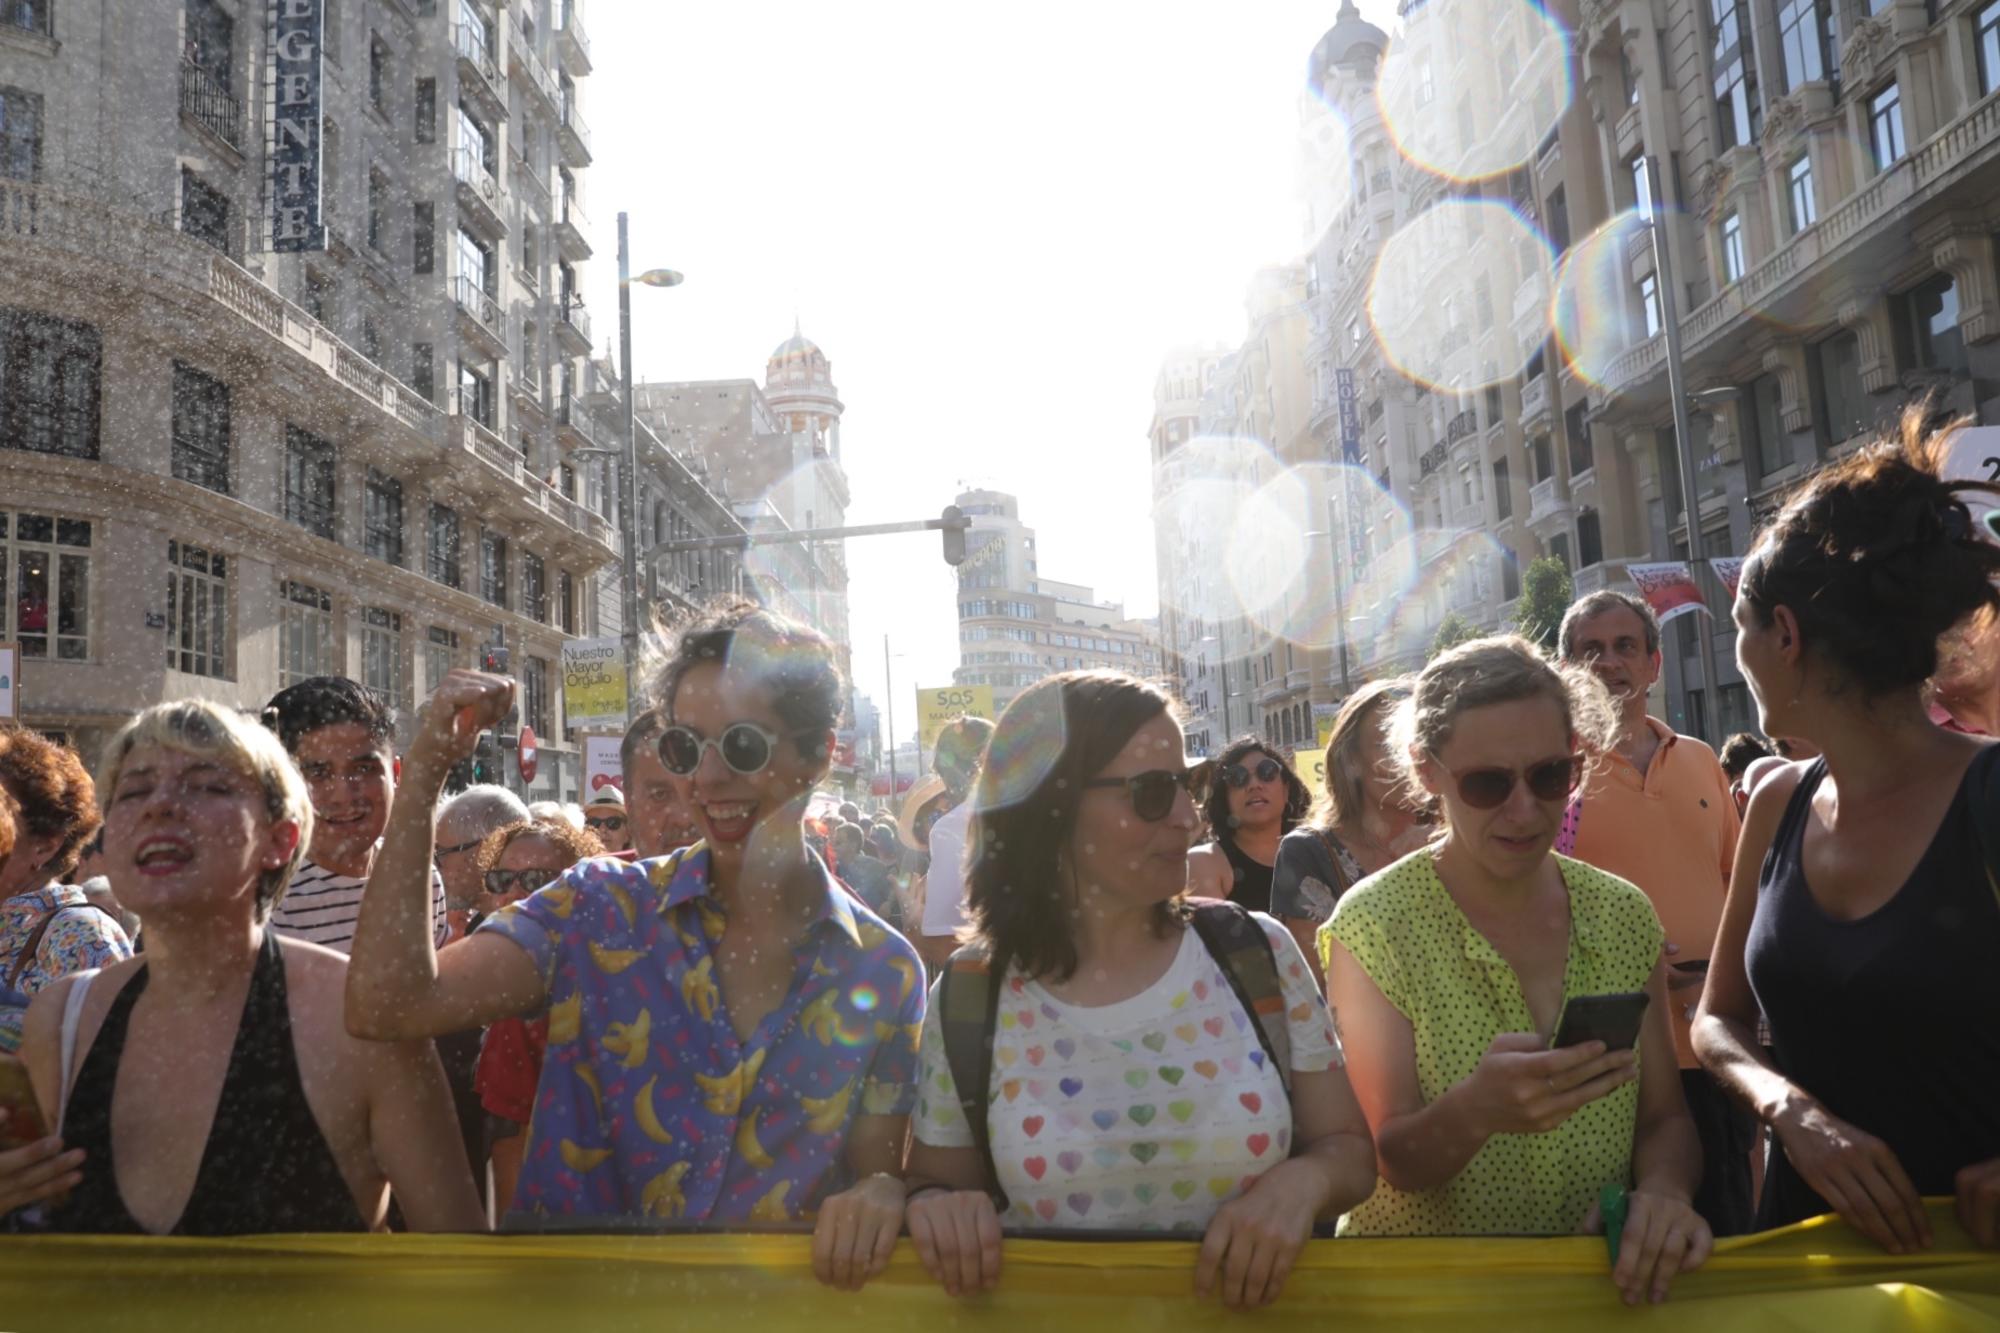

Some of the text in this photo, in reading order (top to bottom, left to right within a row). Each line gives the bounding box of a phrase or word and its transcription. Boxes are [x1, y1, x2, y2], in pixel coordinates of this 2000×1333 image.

[1338, 371, 1356, 441] HOTEL
[564, 647, 614, 661] Nuestro
[566, 661, 605, 674] Mayor
[566, 672, 612, 688] Orgullo
[937, 689, 974, 708] SOS
